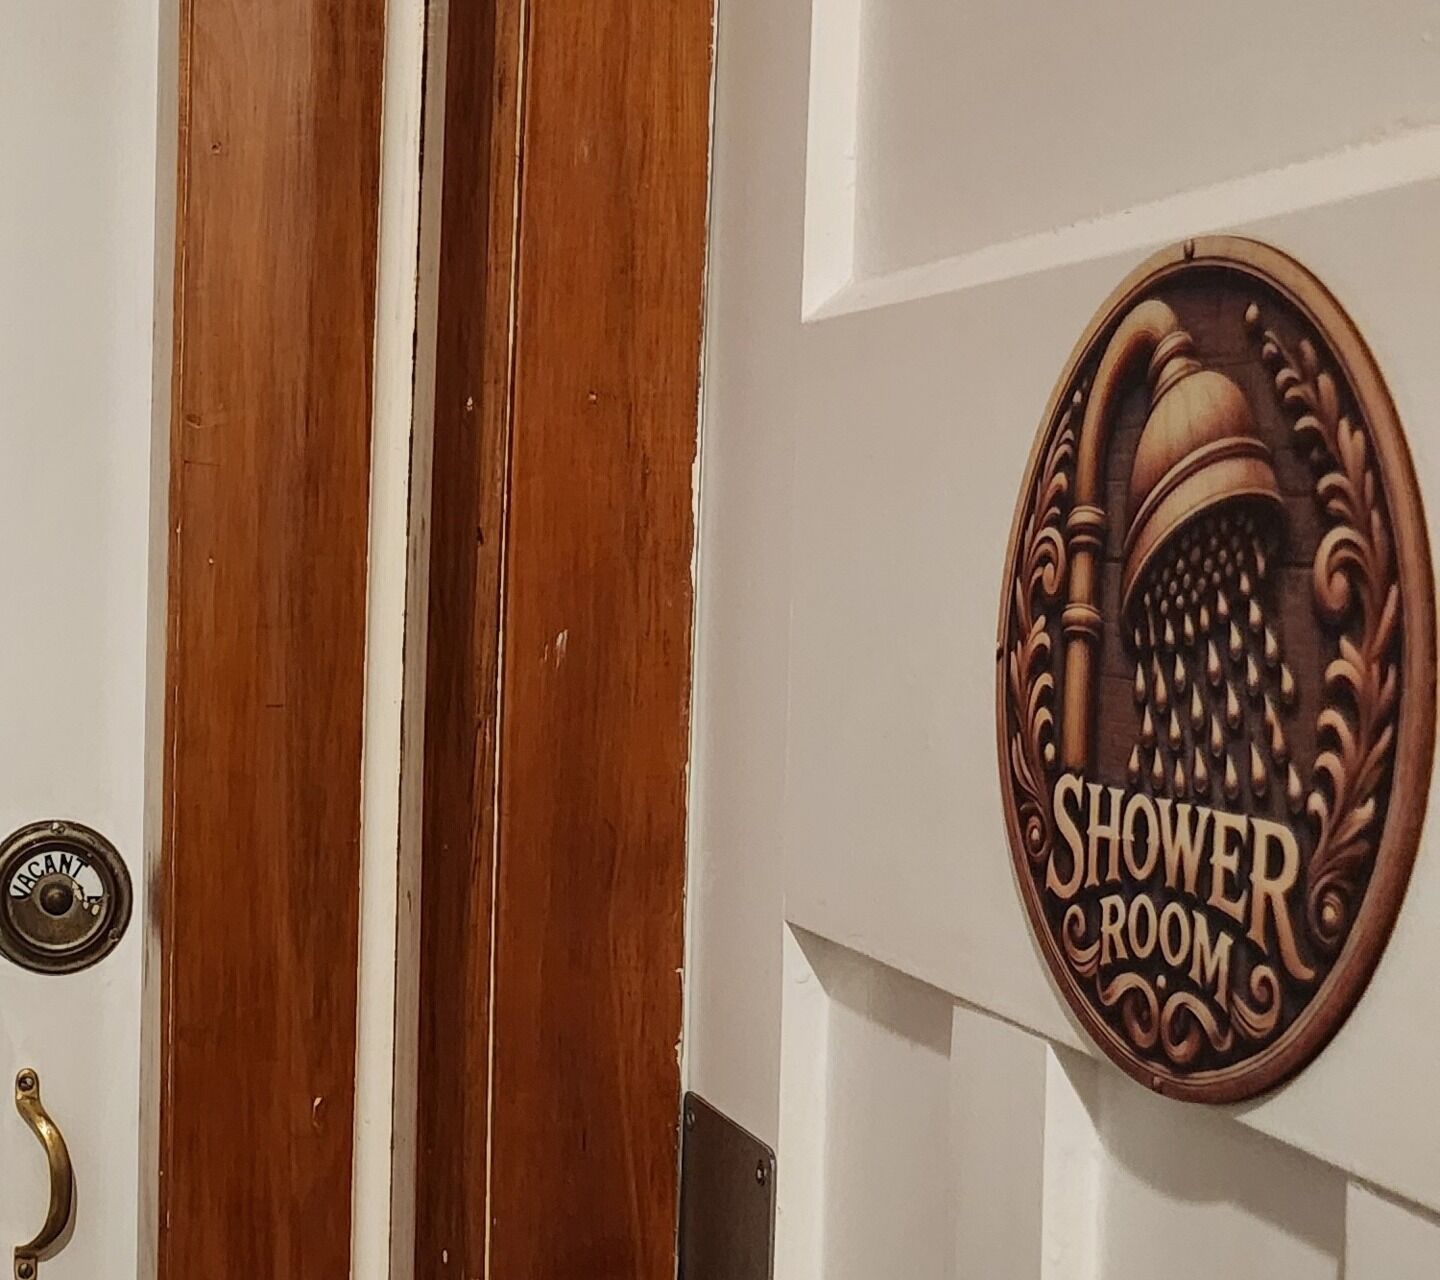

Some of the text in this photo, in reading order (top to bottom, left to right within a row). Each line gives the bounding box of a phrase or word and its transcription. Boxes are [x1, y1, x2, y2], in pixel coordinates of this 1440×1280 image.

[11, 854, 89, 898] VACANT
[1046, 773, 1314, 981] SHOWER
[1099, 895, 1234, 1010] ROOM
